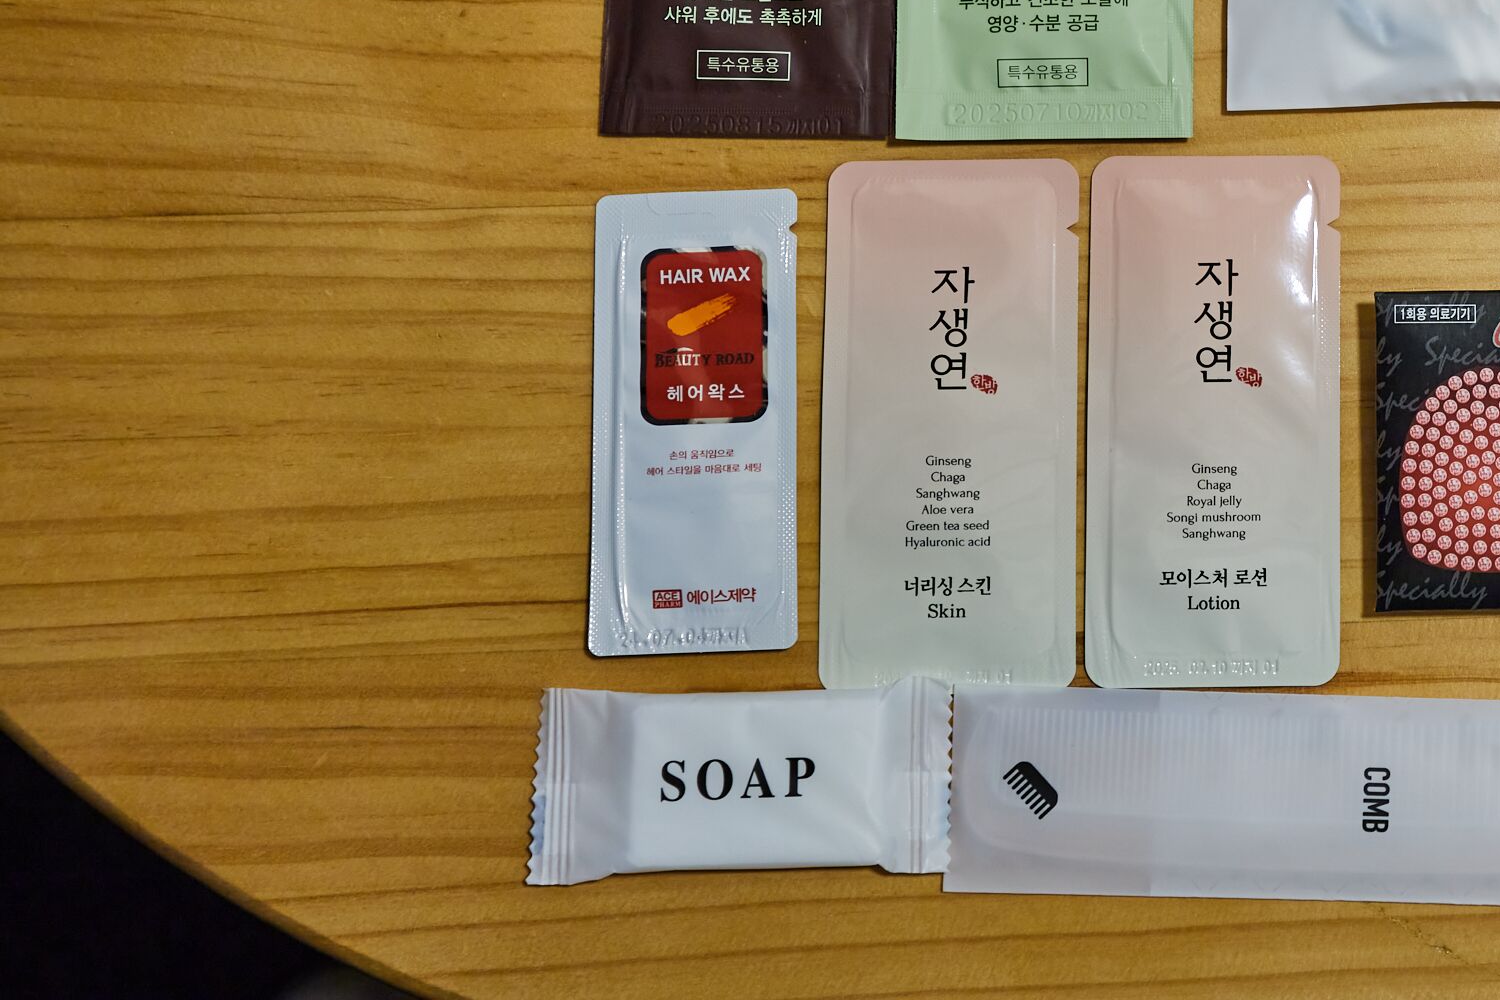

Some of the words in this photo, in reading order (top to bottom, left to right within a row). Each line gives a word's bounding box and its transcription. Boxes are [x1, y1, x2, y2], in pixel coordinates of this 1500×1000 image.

[664, 6, 697, 24] 샤워
[703, 6, 753, 25] 후에도
[759, 8, 823, 26] 촉촉하게
[1067, 14, 1099, 32] 공급
[707, 57, 779, 74] 특수유통용
[1007, 64, 1078, 80] 특수유통용
[659, 268, 704, 285] HAIR
[709, 266, 751, 283] WAX
[1194, 258, 1239, 382] 자생연
[1400, 307, 1427, 321] 1회용
[1430, 307, 1471, 321] 의료기기
[929, 266, 976, 390] 자생연
[716, 352, 754, 366] ROAD
[666, 383, 745, 402] 헤어왁스
[925, 455, 972, 468] Ginseng
[1191, 463, 1238, 476] Ginseng
[931, 471, 966, 484] Chaga
[1197, 479, 1232, 492] Chaga
[916, 488, 980, 501] Sanghwang
[1186, 495, 1216, 508] Royal
[1220, 495, 1242, 508] jelly
[922, 504, 947, 515] Aloe
[950, 506, 974, 515] vera
[906, 521, 940, 531] Green
[943, 521, 960, 531] tea
[963, 520, 990, 531] seed
[1166, 511, 1198, 525] Songi
[1201, 511, 1261, 523] mushroom
[1182, 528, 1246, 541] Sanghwang
[905, 536, 965, 550] Hyaluronic
[968, 536, 991, 547] acid
[904, 576, 953, 597] 너리싱
[957, 575, 991, 596] 스킨
[1159, 568, 1228, 589] 모이스처
[1233, 567, 1268, 588] 로션
[656, 592, 679, 601] ACE
[686, 588, 757, 604] 에이스제약
[1187, 595, 1241, 611] Lotion
[927, 603, 966, 619] Skin
[660, 757, 816, 802] SOAP
[1362, 767, 1391, 834] COMB
